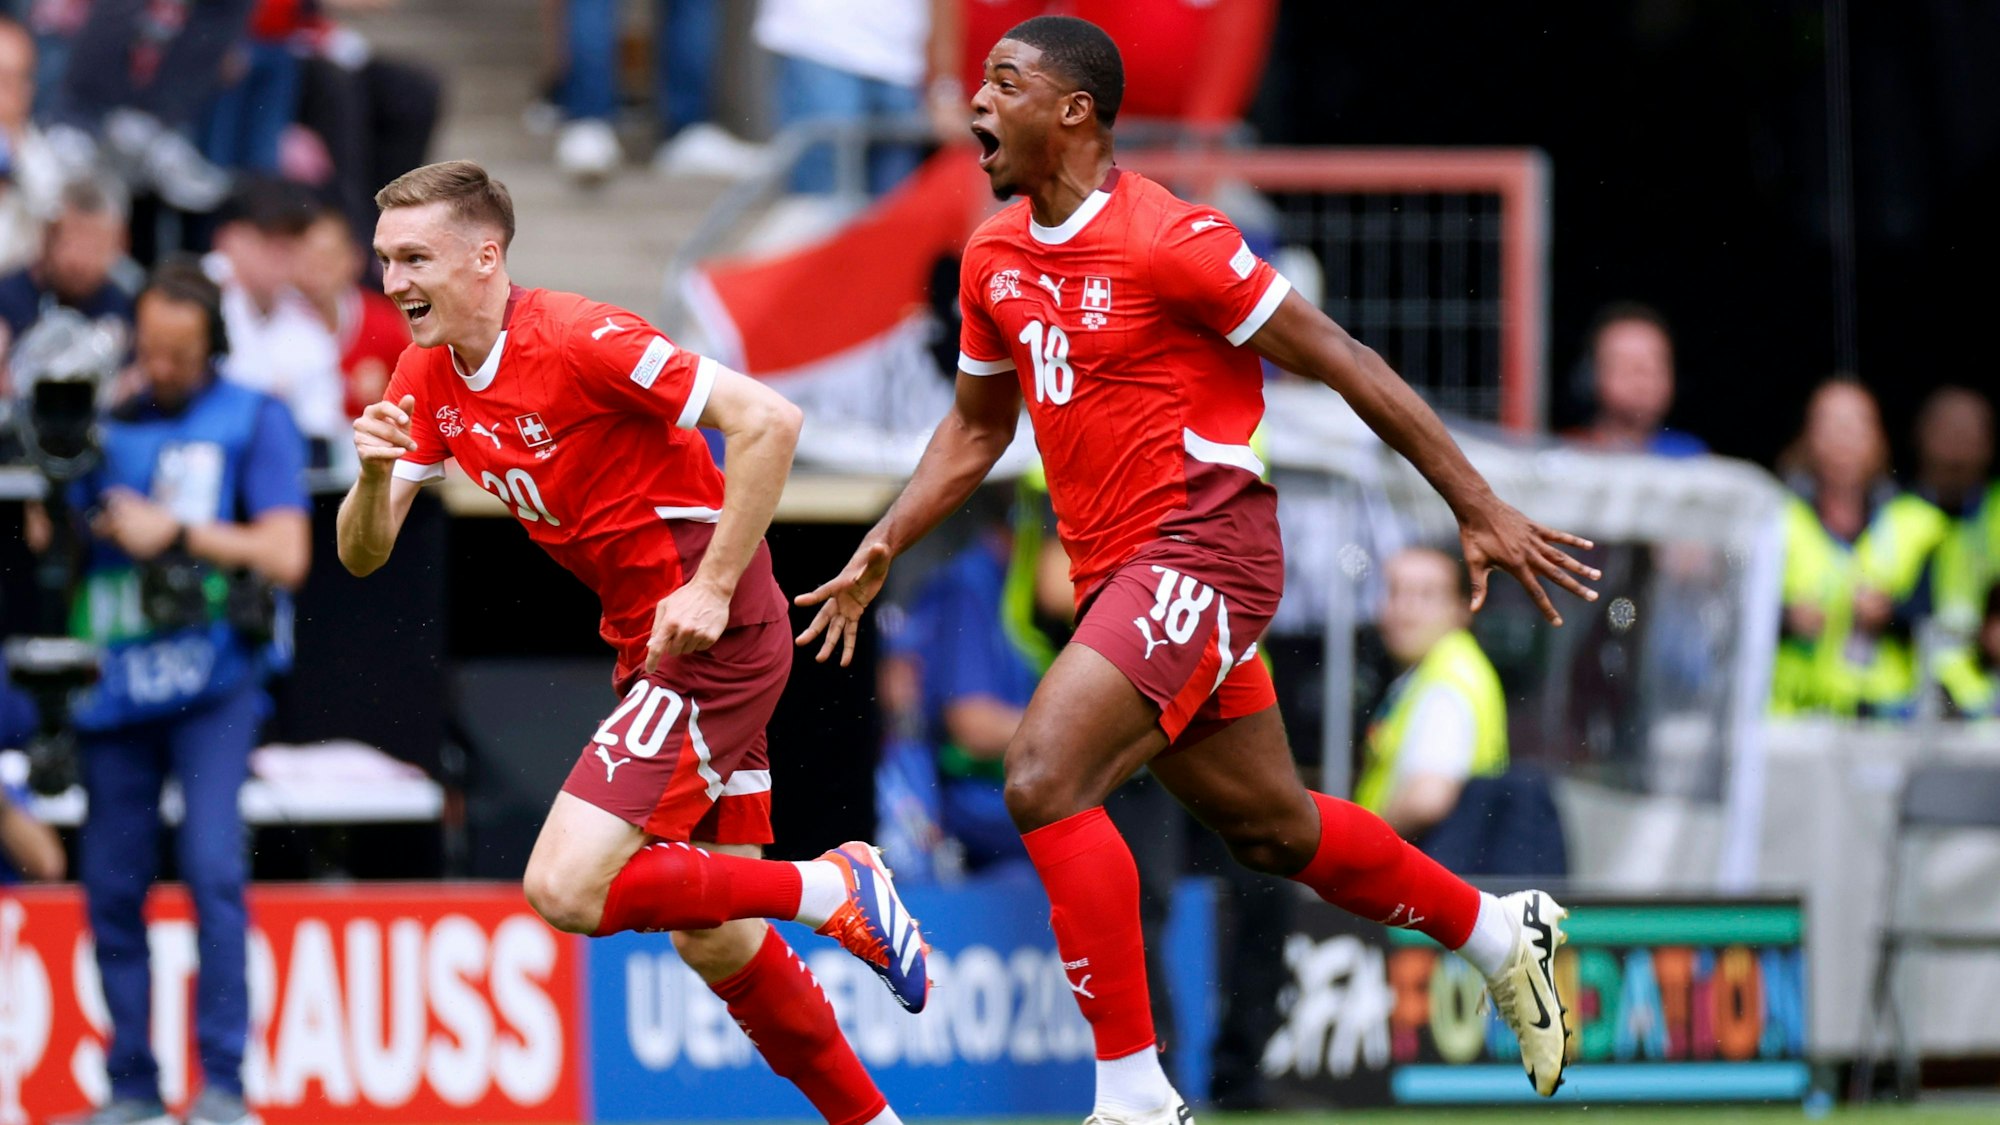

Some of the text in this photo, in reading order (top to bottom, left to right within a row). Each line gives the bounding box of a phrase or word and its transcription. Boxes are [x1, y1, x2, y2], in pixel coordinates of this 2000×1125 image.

[1019, 320, 1074, 405] 18
[481, 468, 560, 526] 20
[1149, 565, 1214, 644] 18
[593, 679, 684, 758] 20
[1389, 946, 1807, 1063] FODATION
